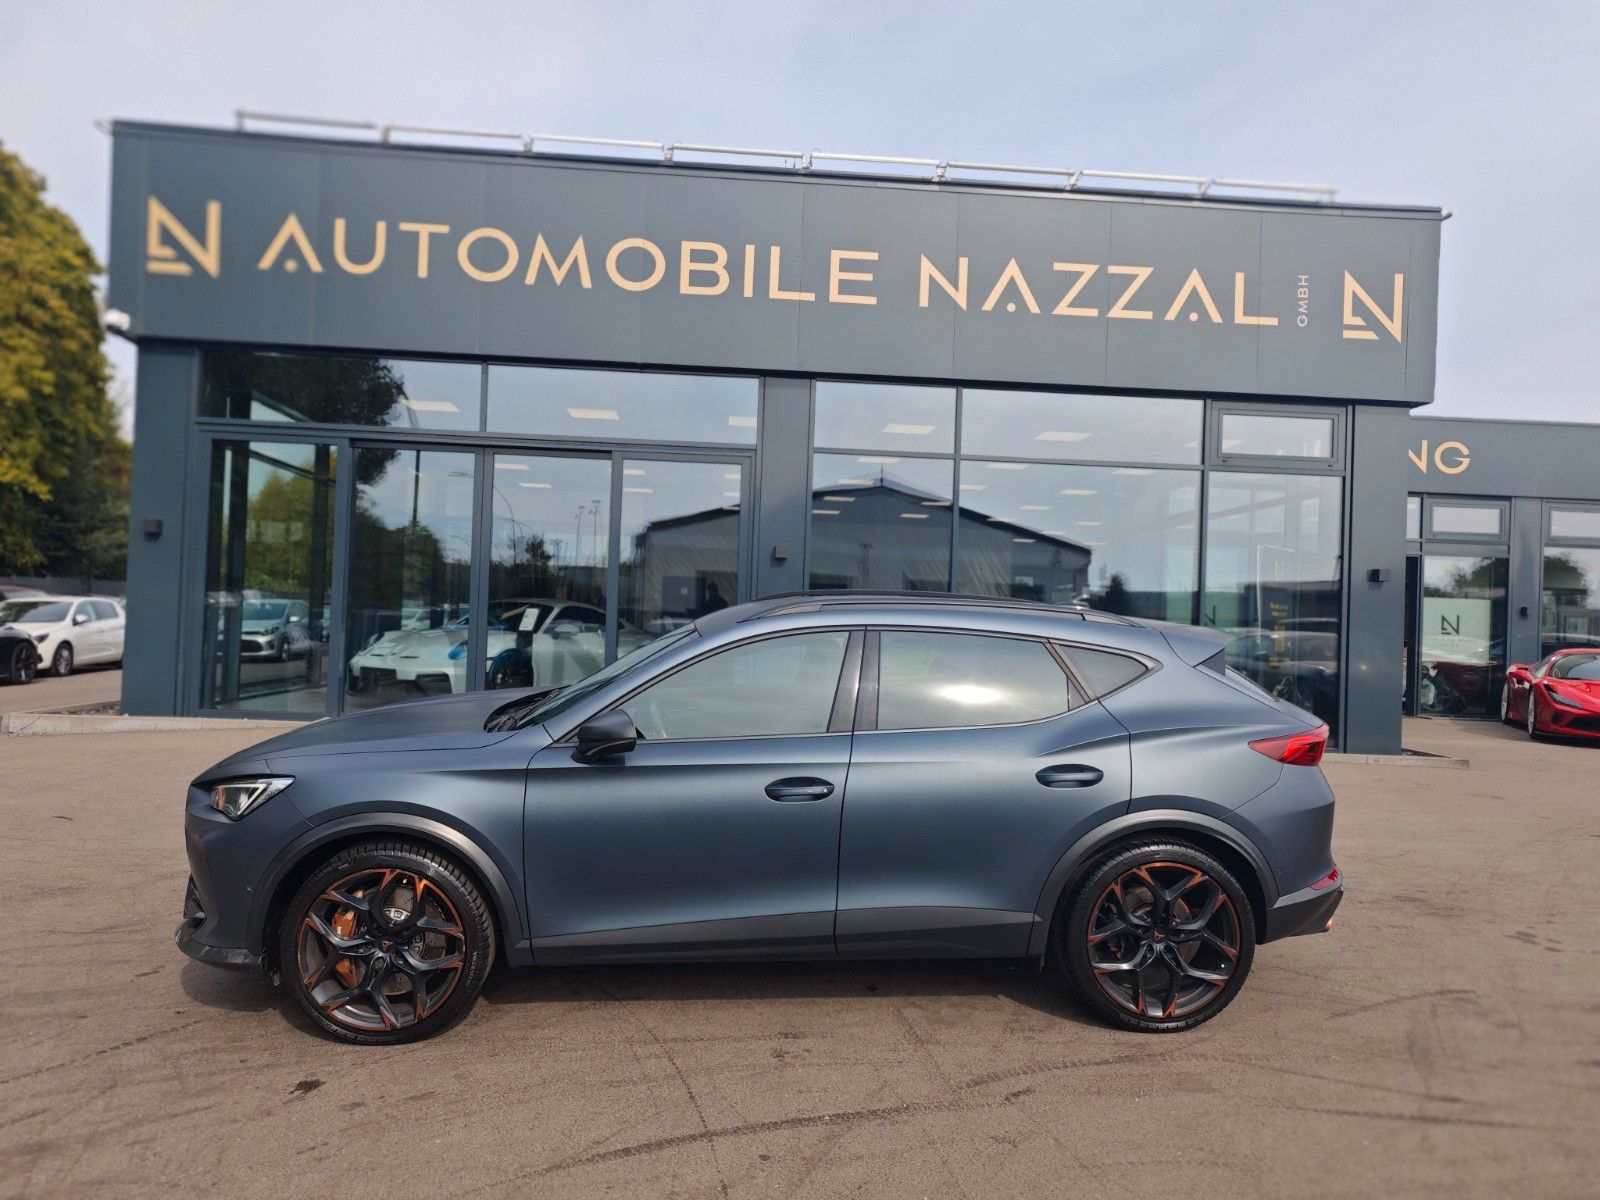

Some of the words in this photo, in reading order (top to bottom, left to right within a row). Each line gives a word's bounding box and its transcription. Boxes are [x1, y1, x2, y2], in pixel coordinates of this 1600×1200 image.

[258, 214, 880, 306] AUTOMOBILE
[918, 254, 1280, 328] NAZZAL
[1297, 274, 1309, 327] GMBH
